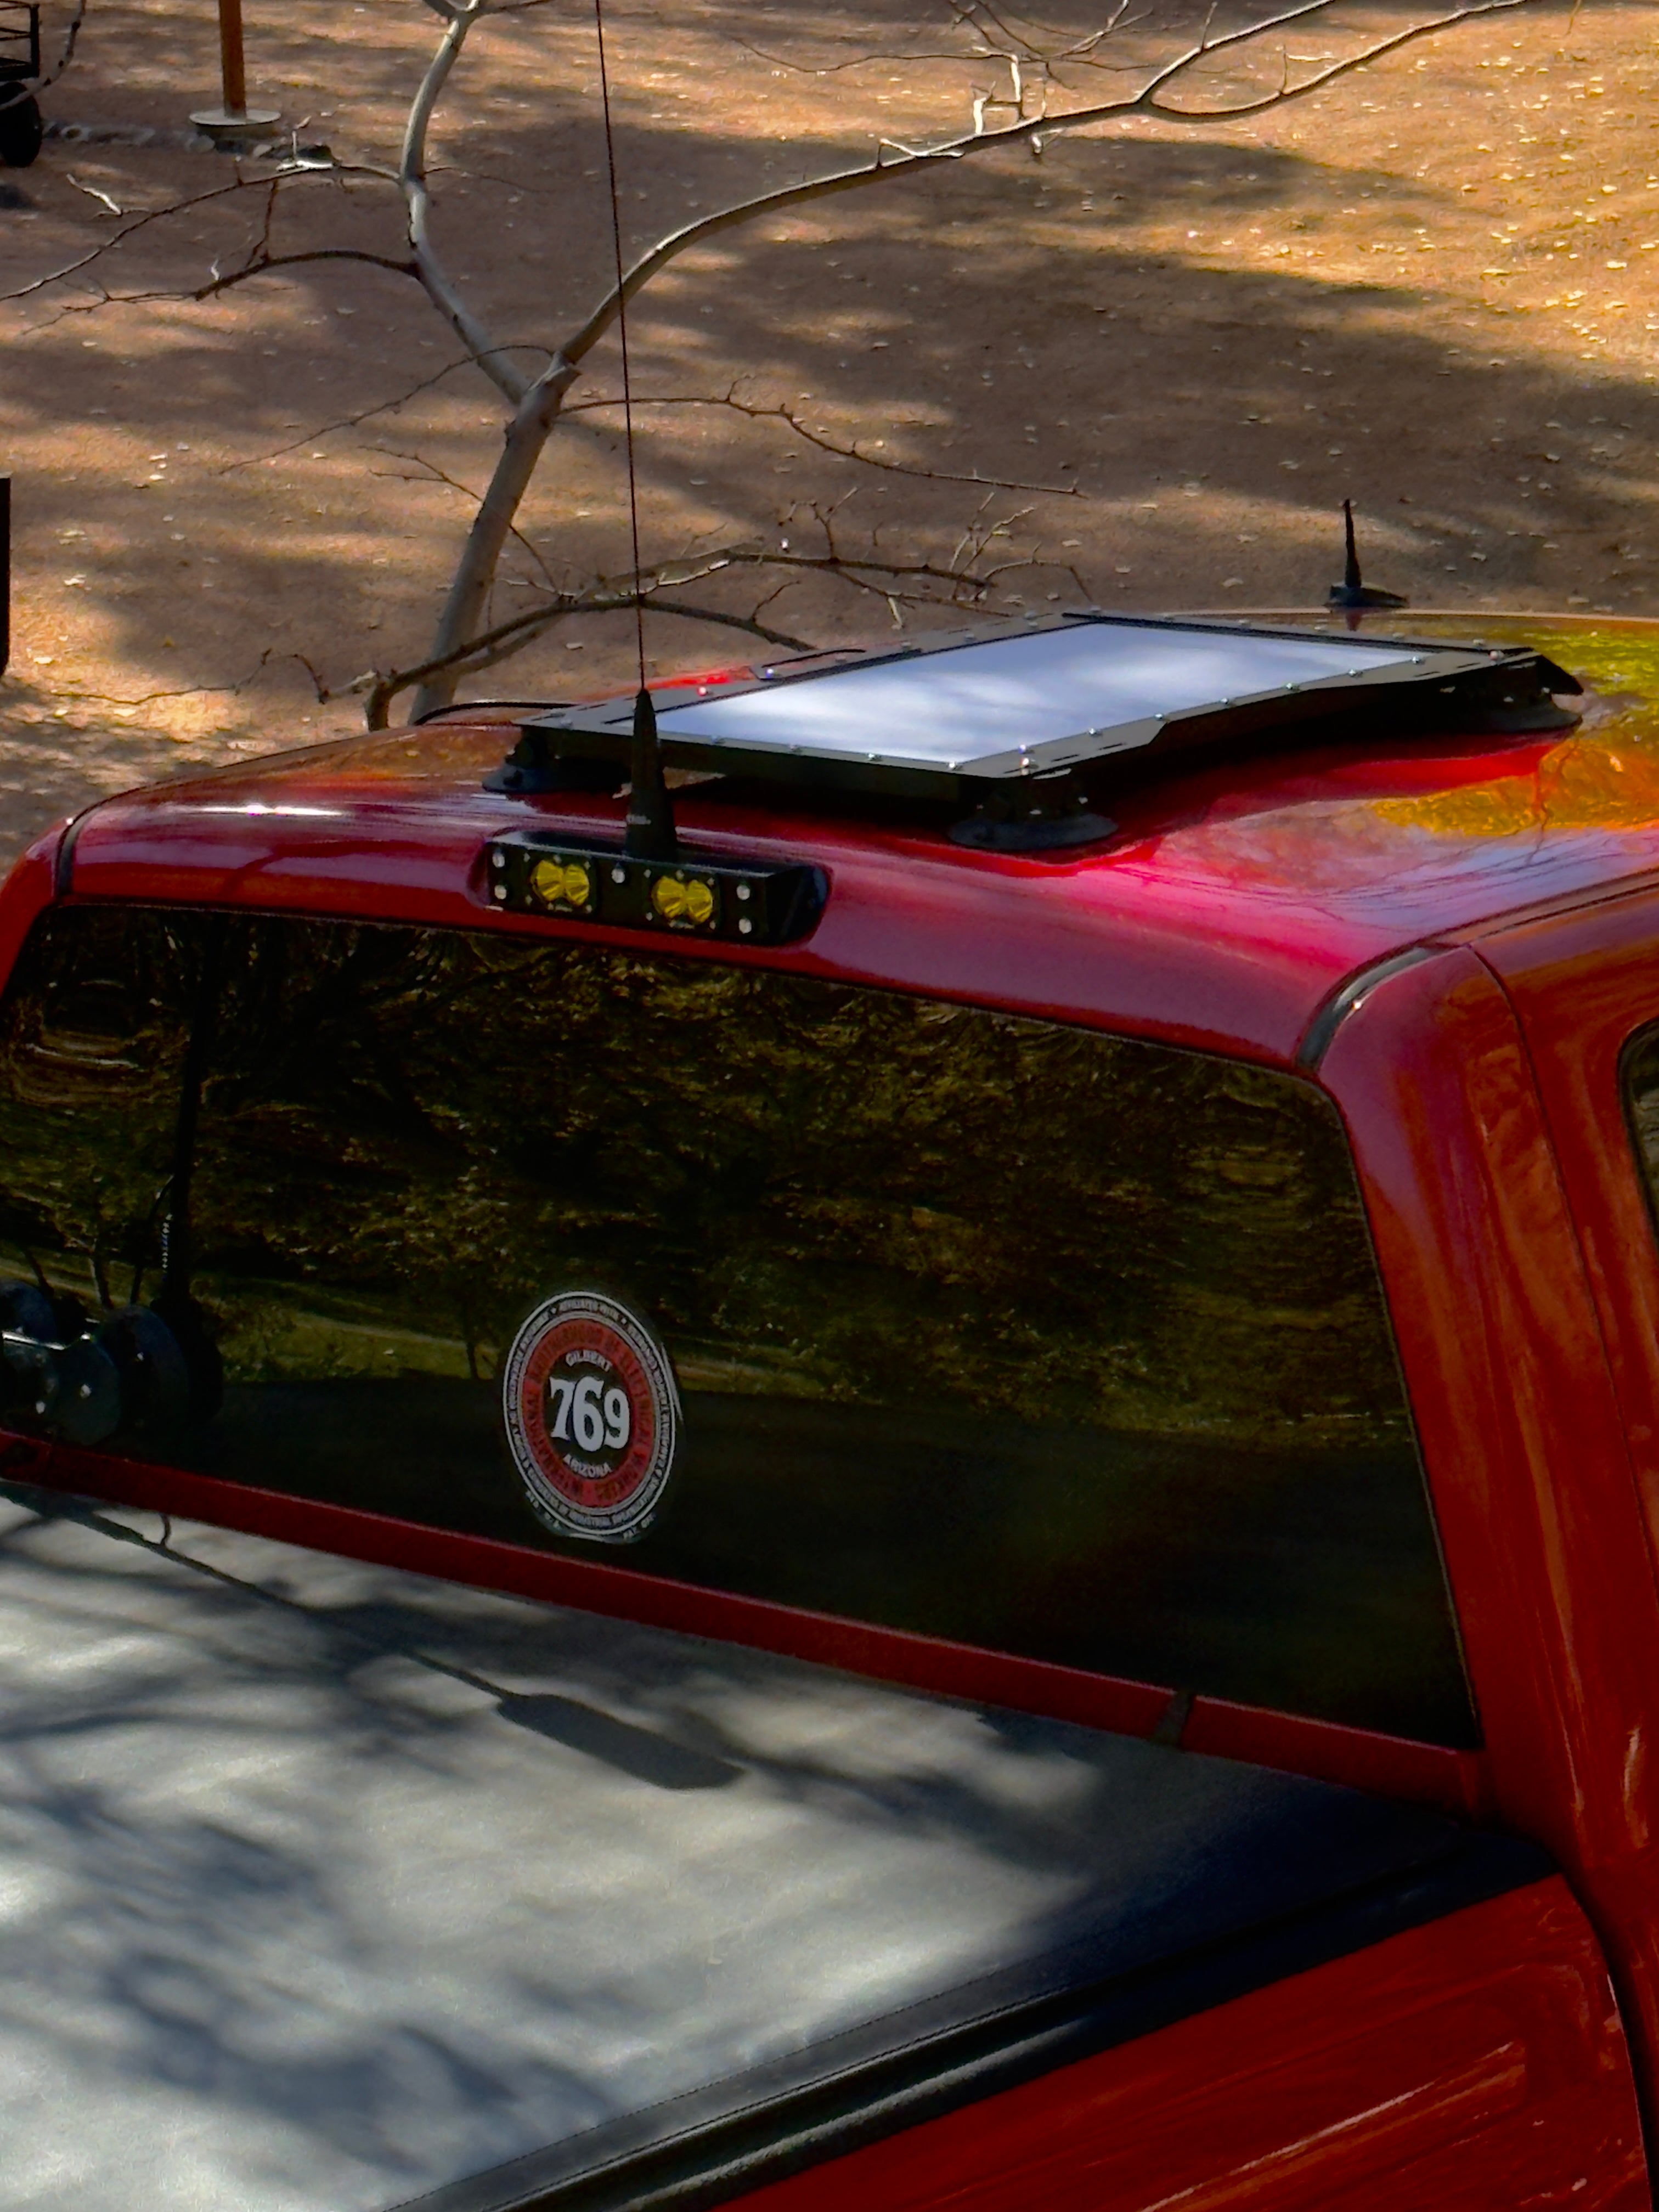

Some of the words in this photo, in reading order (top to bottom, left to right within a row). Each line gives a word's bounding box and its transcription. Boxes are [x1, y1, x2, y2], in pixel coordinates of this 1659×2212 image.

[565, 1349, 613, 1373] GILBERT
[549, 1376, 630, 1452] 769
[562, 1454, 613, 1478] ARIZONA
